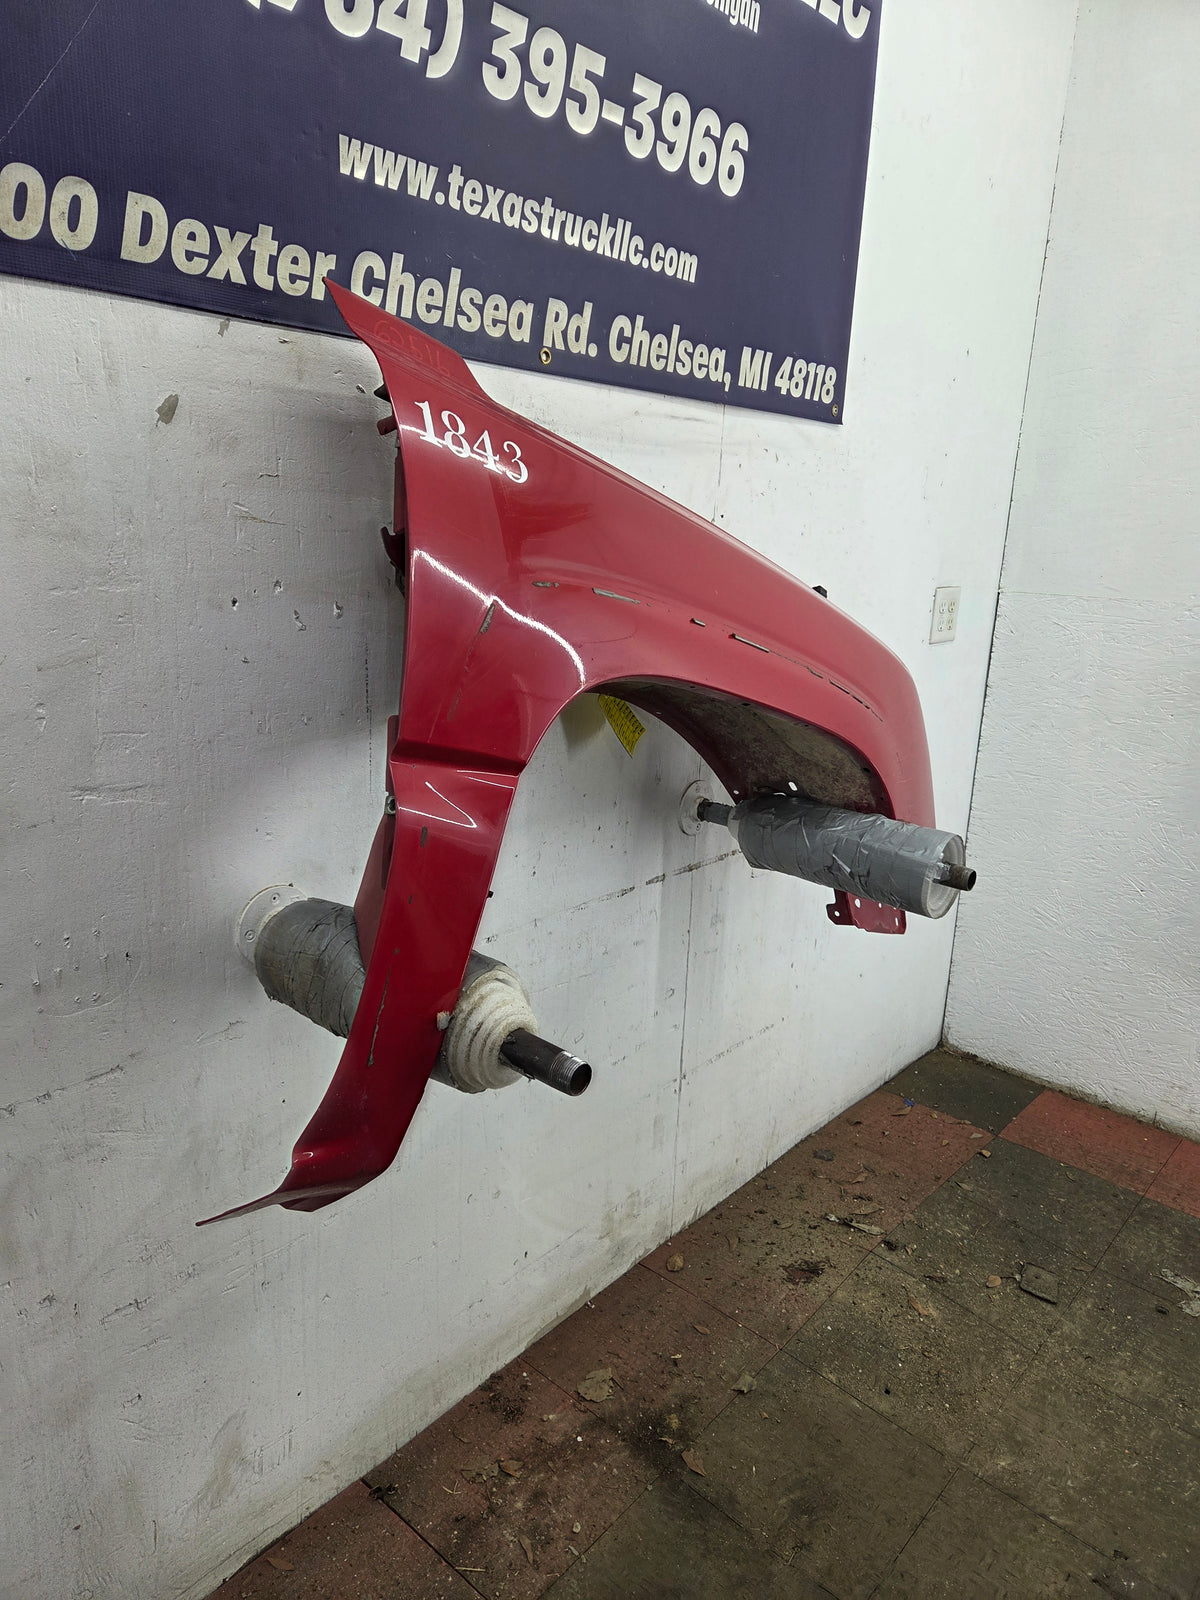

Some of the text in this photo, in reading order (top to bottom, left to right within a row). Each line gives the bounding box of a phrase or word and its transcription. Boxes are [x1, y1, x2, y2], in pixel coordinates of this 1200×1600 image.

[481, 1, 749, 198] 395-3966
[338, 133, 698, 284] www.texastruckllc.com
[120, 190, 337, 301] Dexter
[350, 250, 534, 344] Chelsea
[541, 296, 598, 358] Rd.
[608, 314, 732, 393] Chelsea,
[737, 345, 773, 392] MI
[774, 356, 837, 405] 48118
[413, 399, 530, 485] 1843
